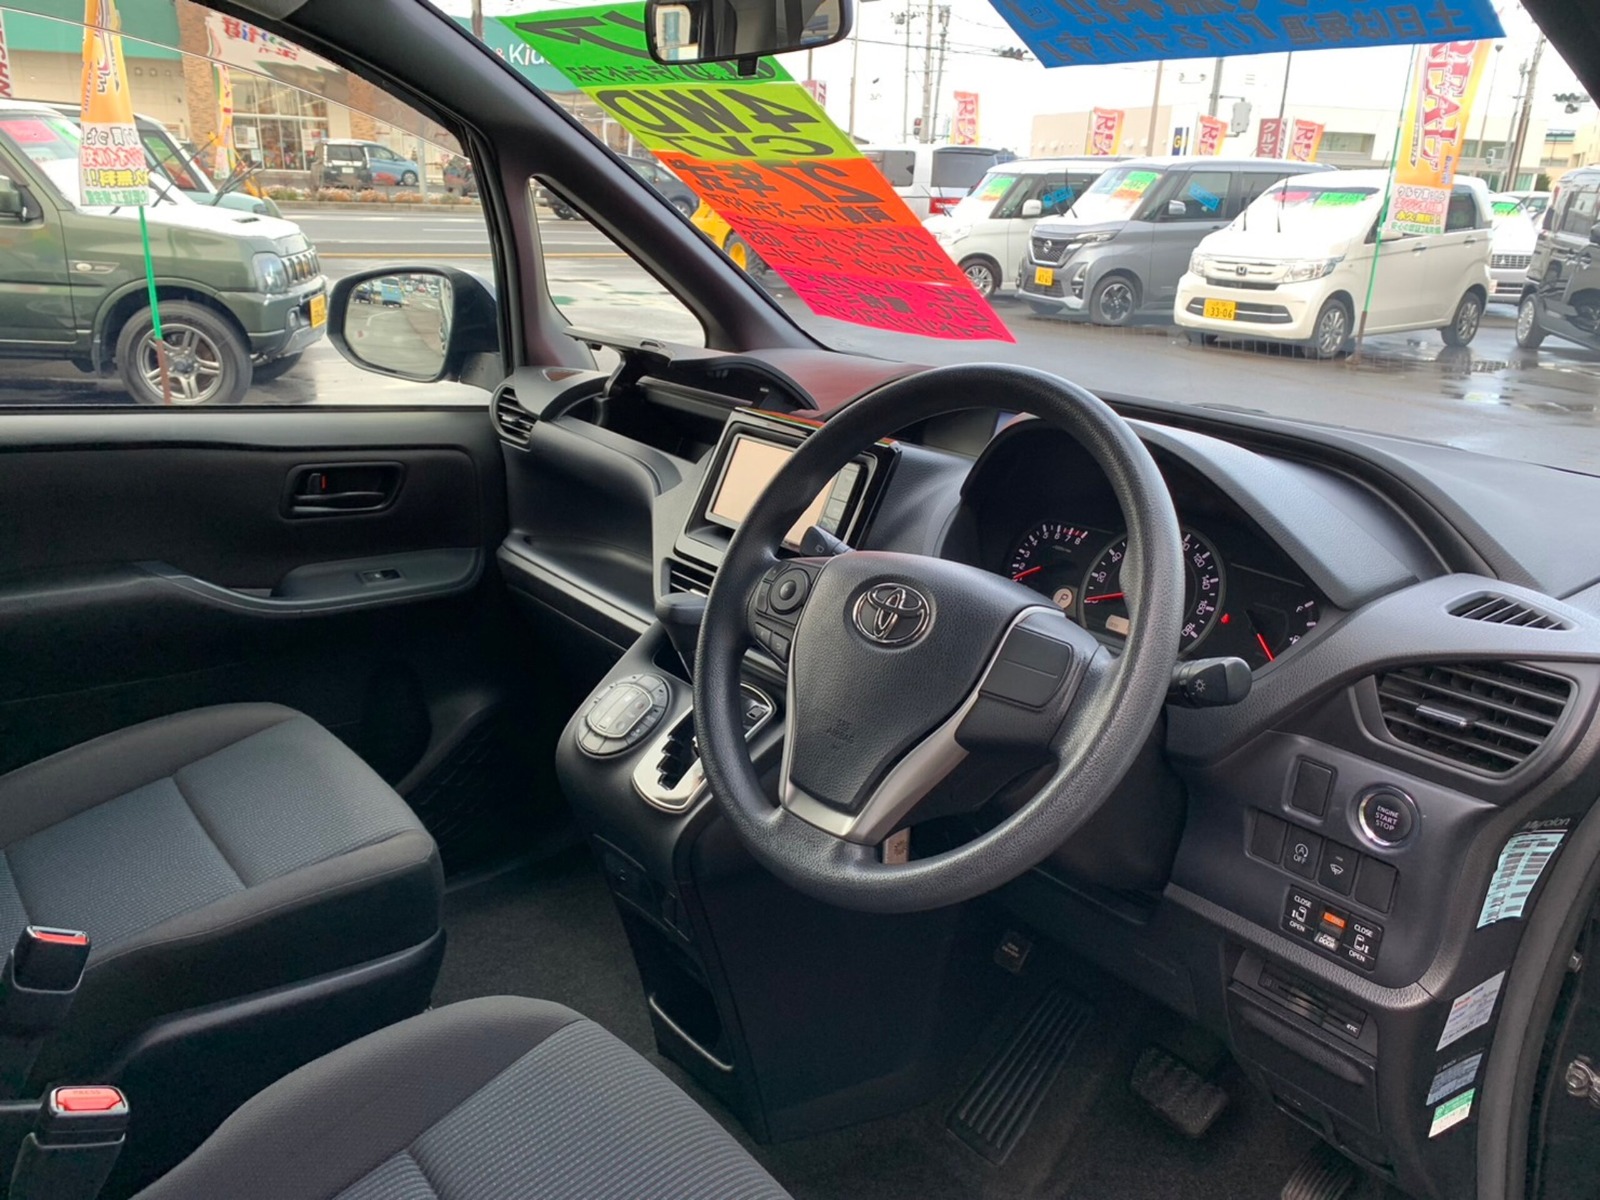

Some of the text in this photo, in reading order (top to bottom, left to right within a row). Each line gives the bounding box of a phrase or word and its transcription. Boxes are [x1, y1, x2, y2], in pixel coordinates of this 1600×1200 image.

[509, 43, 551, 65] Kid
[1260, 121, 1278, 158] クルマ
[1376, 805, 1399, 817] ENGINE
[1374, 812, 1398, 825] START
[1375, 819, 1395, 831] STOP
[1293, 854, 1306, 864] OFF
[1294, 894, 1312, 908] CLOSE
[1289, 920, 1306, 932] OPEN
[1353, 923, 1374, 937] CLOSE
[1348, 949, 1366, 962] OPEN
